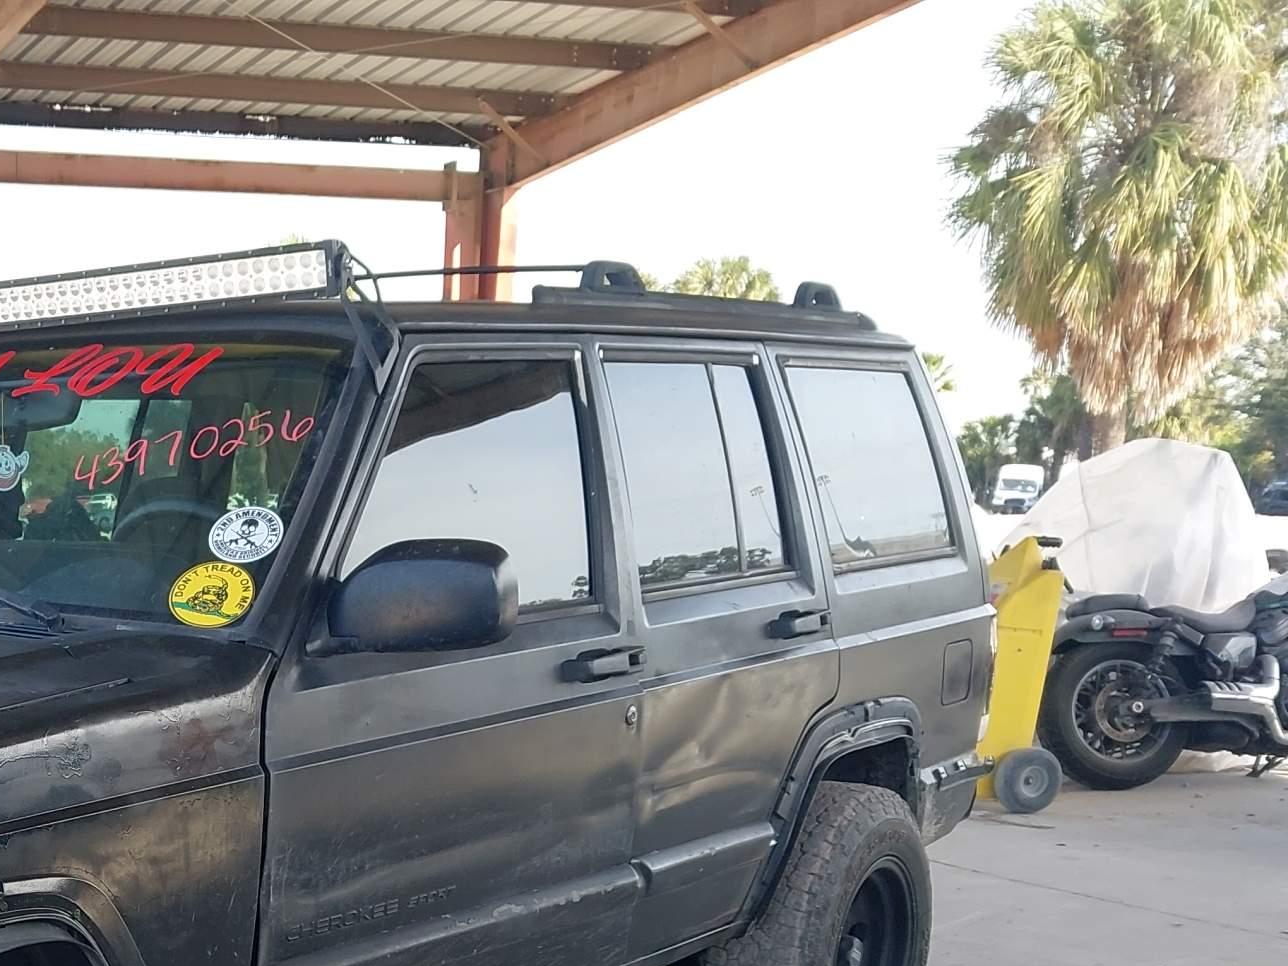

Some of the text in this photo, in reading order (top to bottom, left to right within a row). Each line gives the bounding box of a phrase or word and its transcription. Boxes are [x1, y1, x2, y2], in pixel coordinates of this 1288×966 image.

[11, 342, 224, 399] LOU
[75, 409, 315, 490] 43970256
[218, 510, 279, 537] 2ND AMENDMENT
[174, 564, 253, 611] DON'T TREAD ON ME
[287, 884, 457, 942] CHEROKEE SPORT
